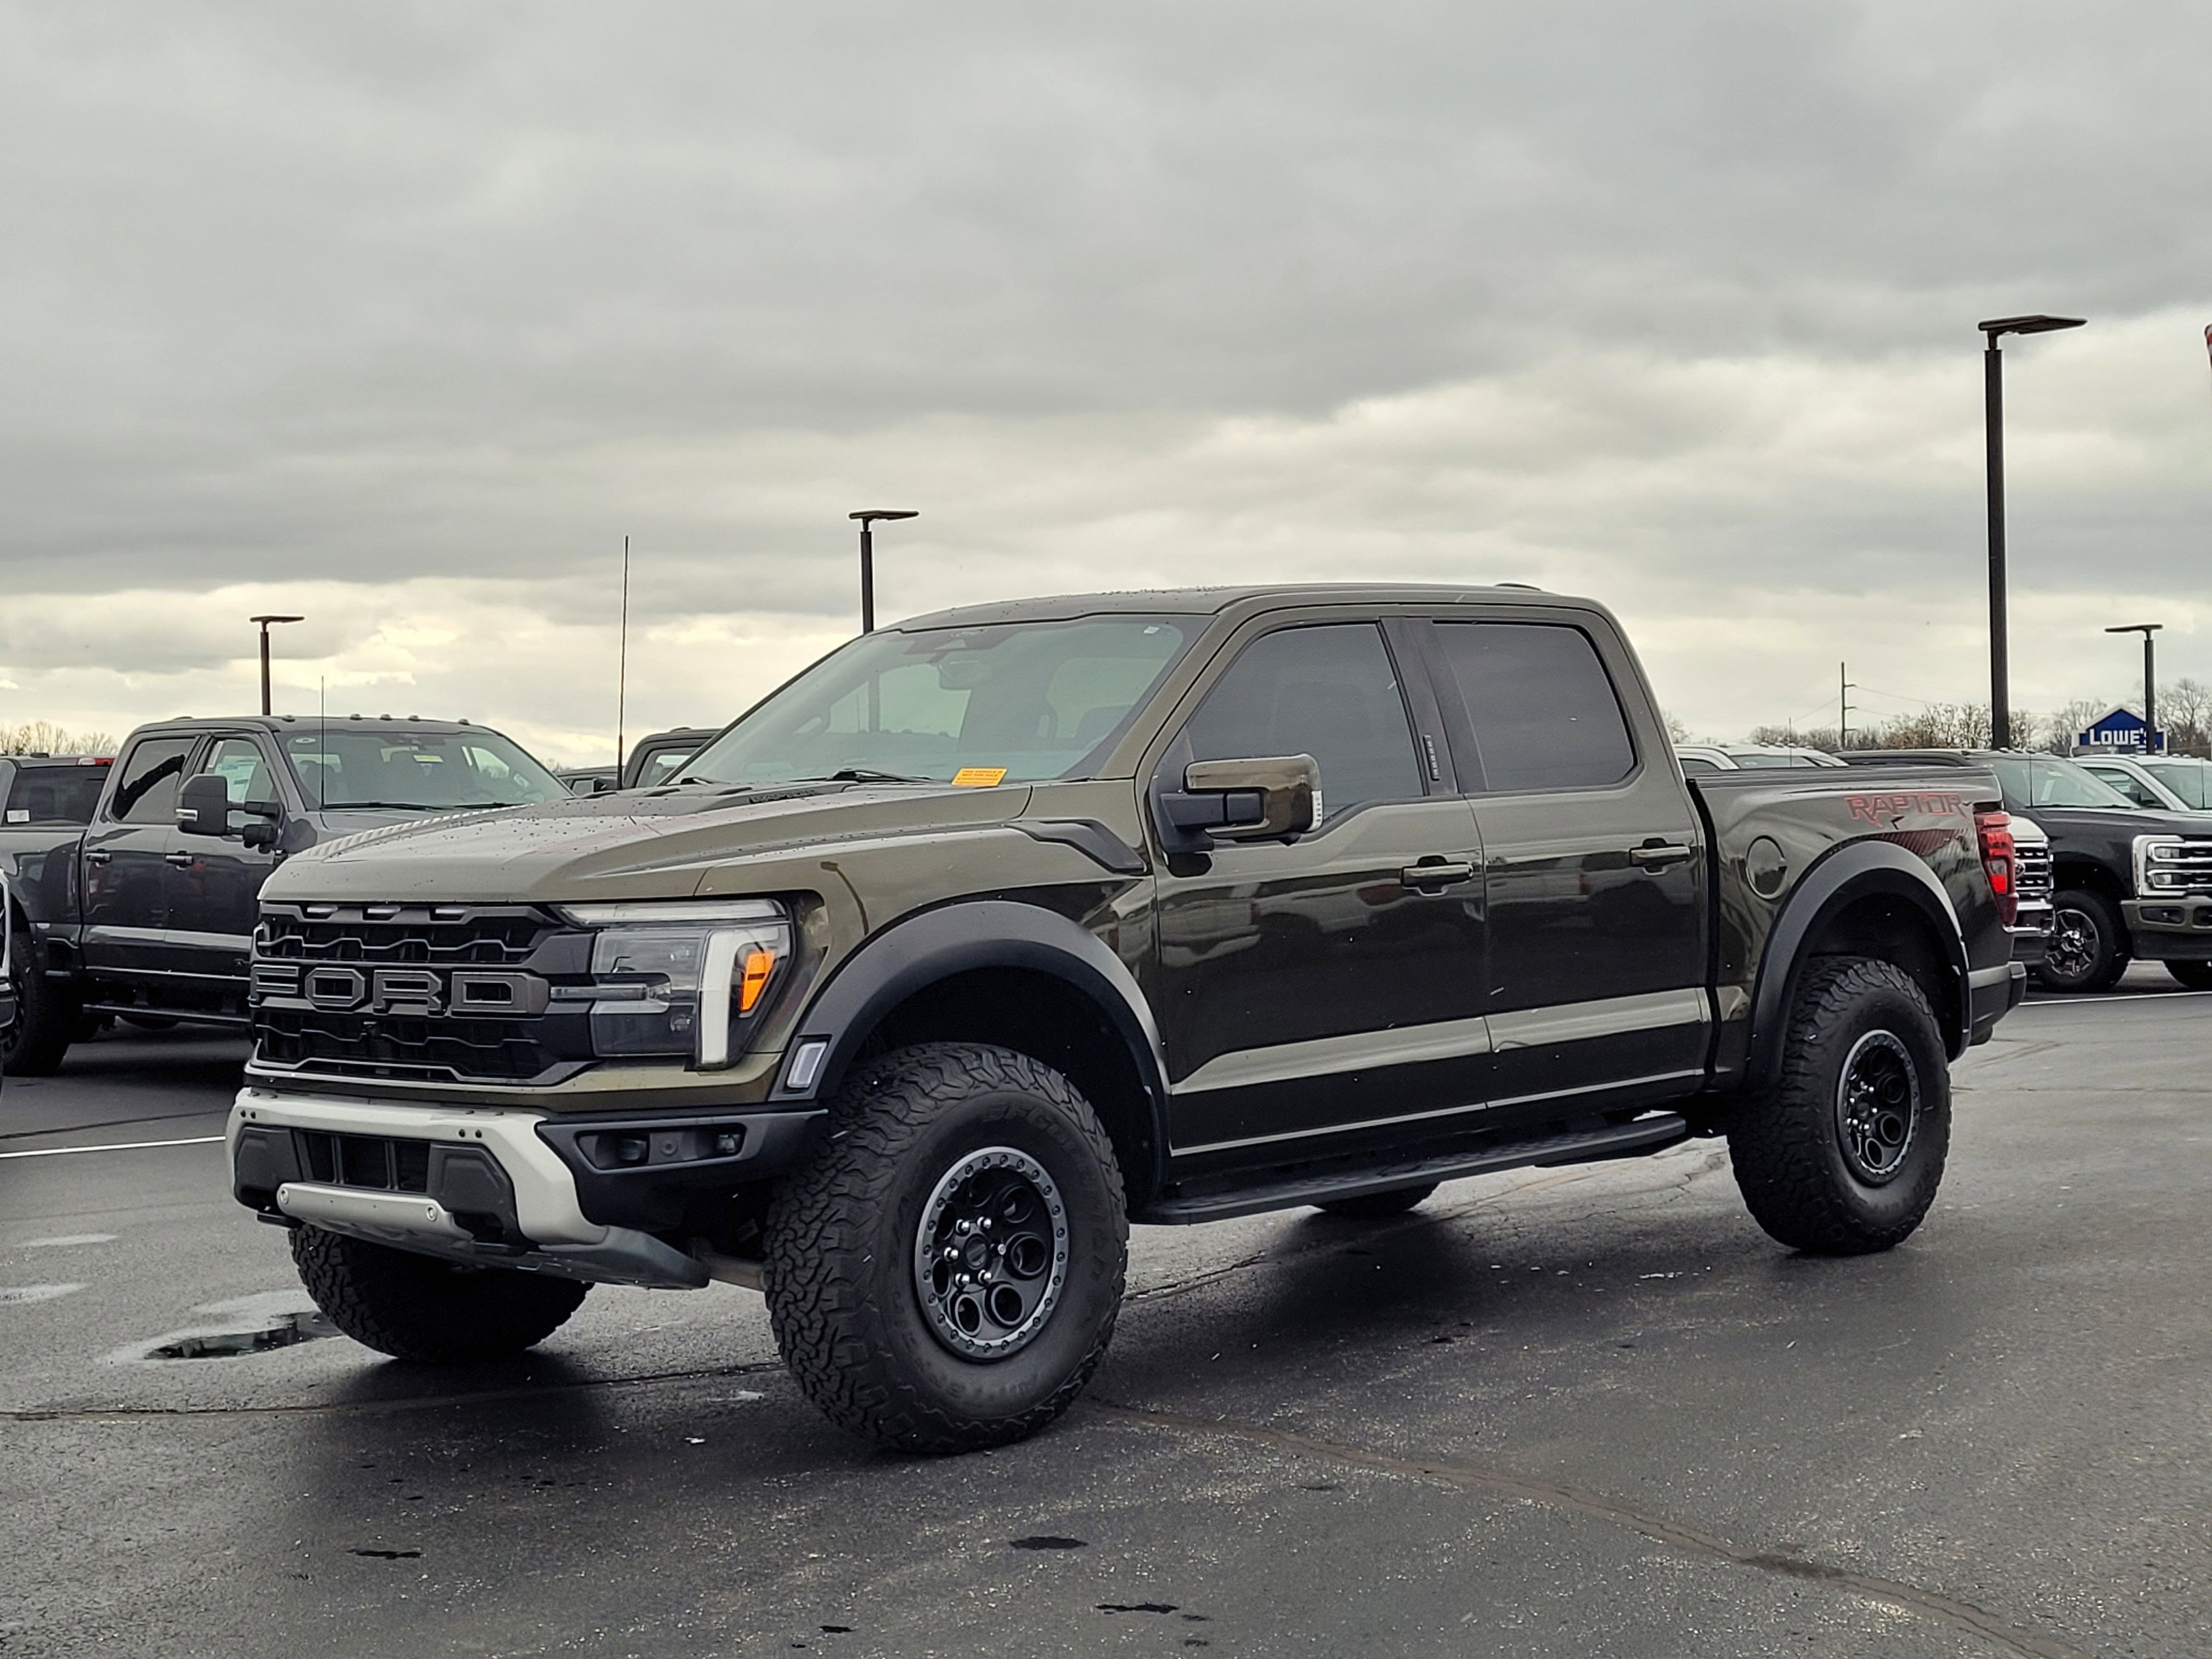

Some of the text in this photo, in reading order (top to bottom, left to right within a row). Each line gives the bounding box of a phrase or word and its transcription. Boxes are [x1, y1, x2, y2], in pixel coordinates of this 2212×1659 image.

[2090, 727, 2147, 745] LOWE'
[1844, 792, 1968, 828] RAPTOR
[250, 964, 549, 1019] FORD
